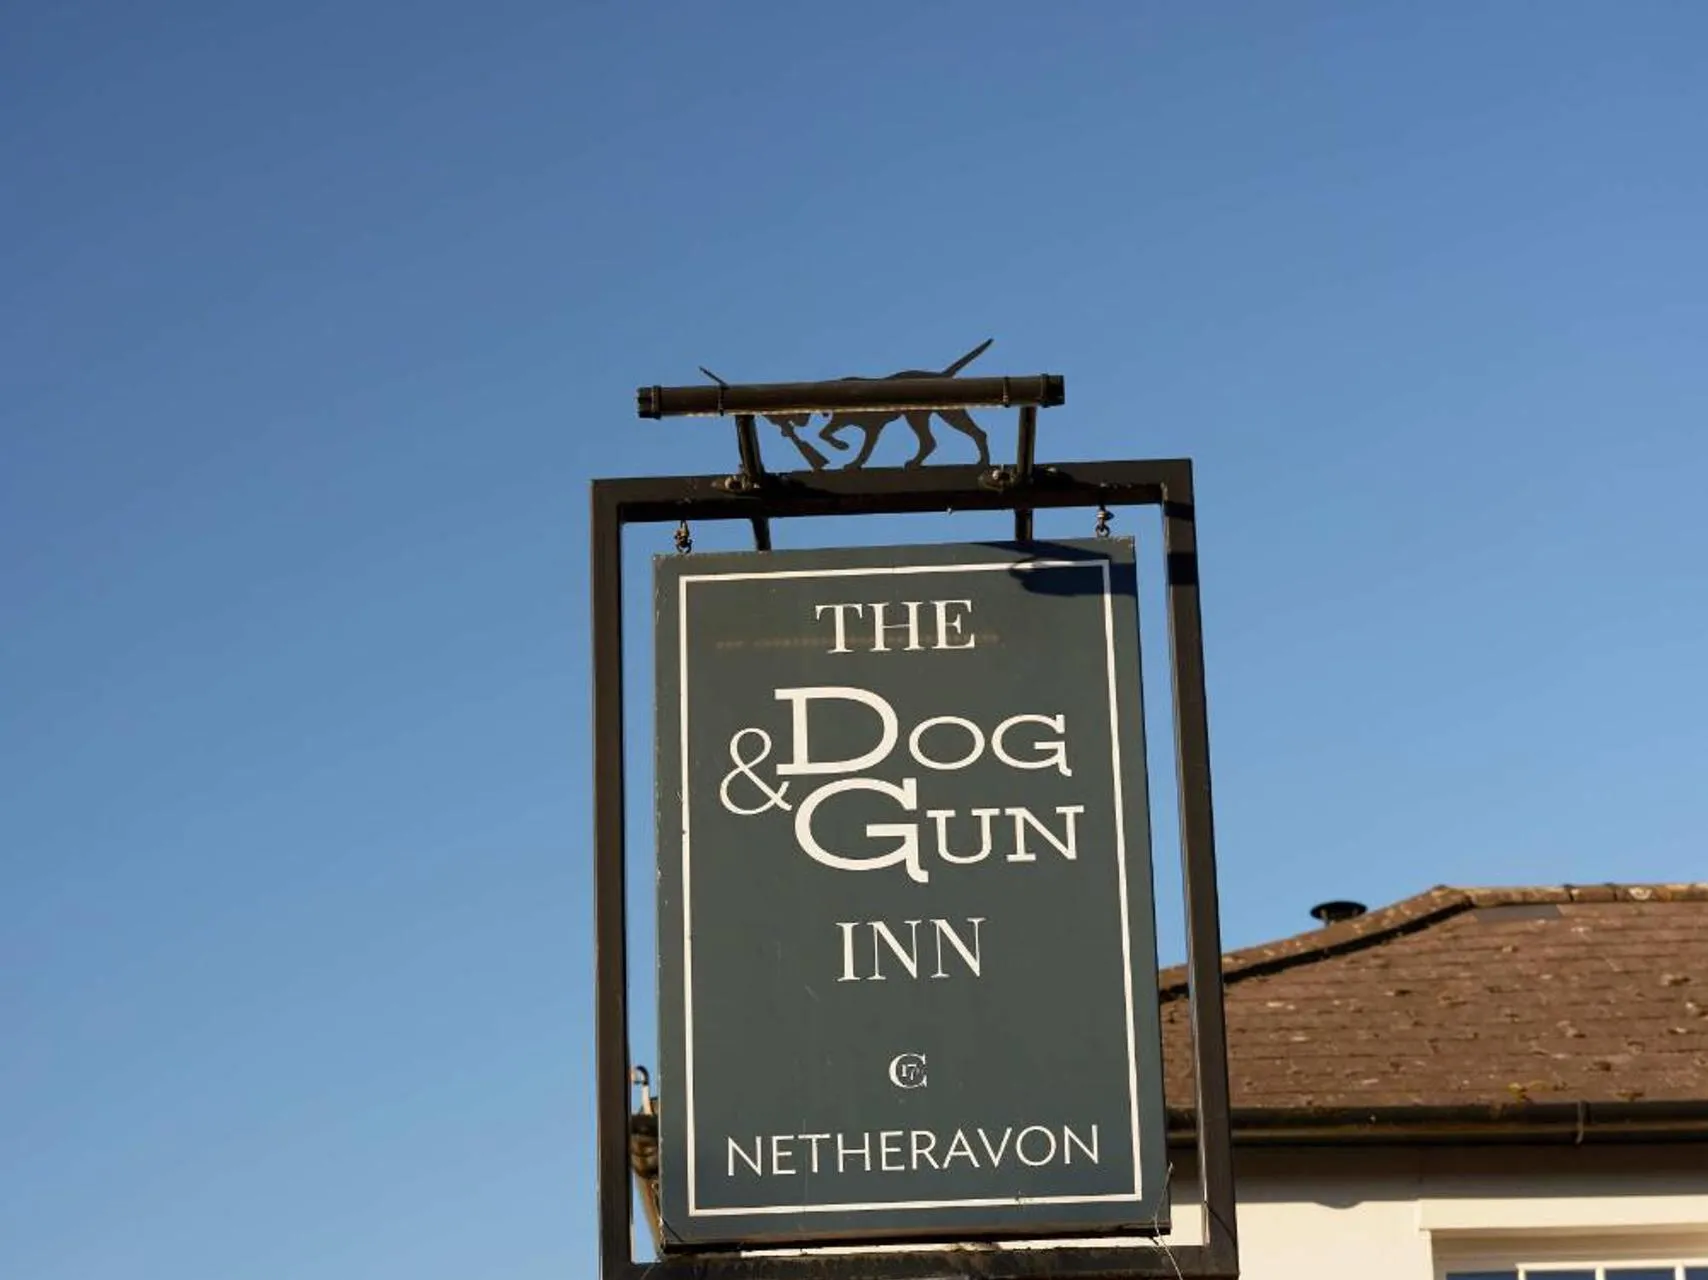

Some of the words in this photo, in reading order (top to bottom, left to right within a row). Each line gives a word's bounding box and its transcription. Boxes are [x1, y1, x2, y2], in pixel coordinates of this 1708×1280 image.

[814, 599, 976, 654] THE
[720, 727, 793, 816] &
[836, 917, 986, 982] INN
[727, 1123, 1103, 1177] NETHERAVON
